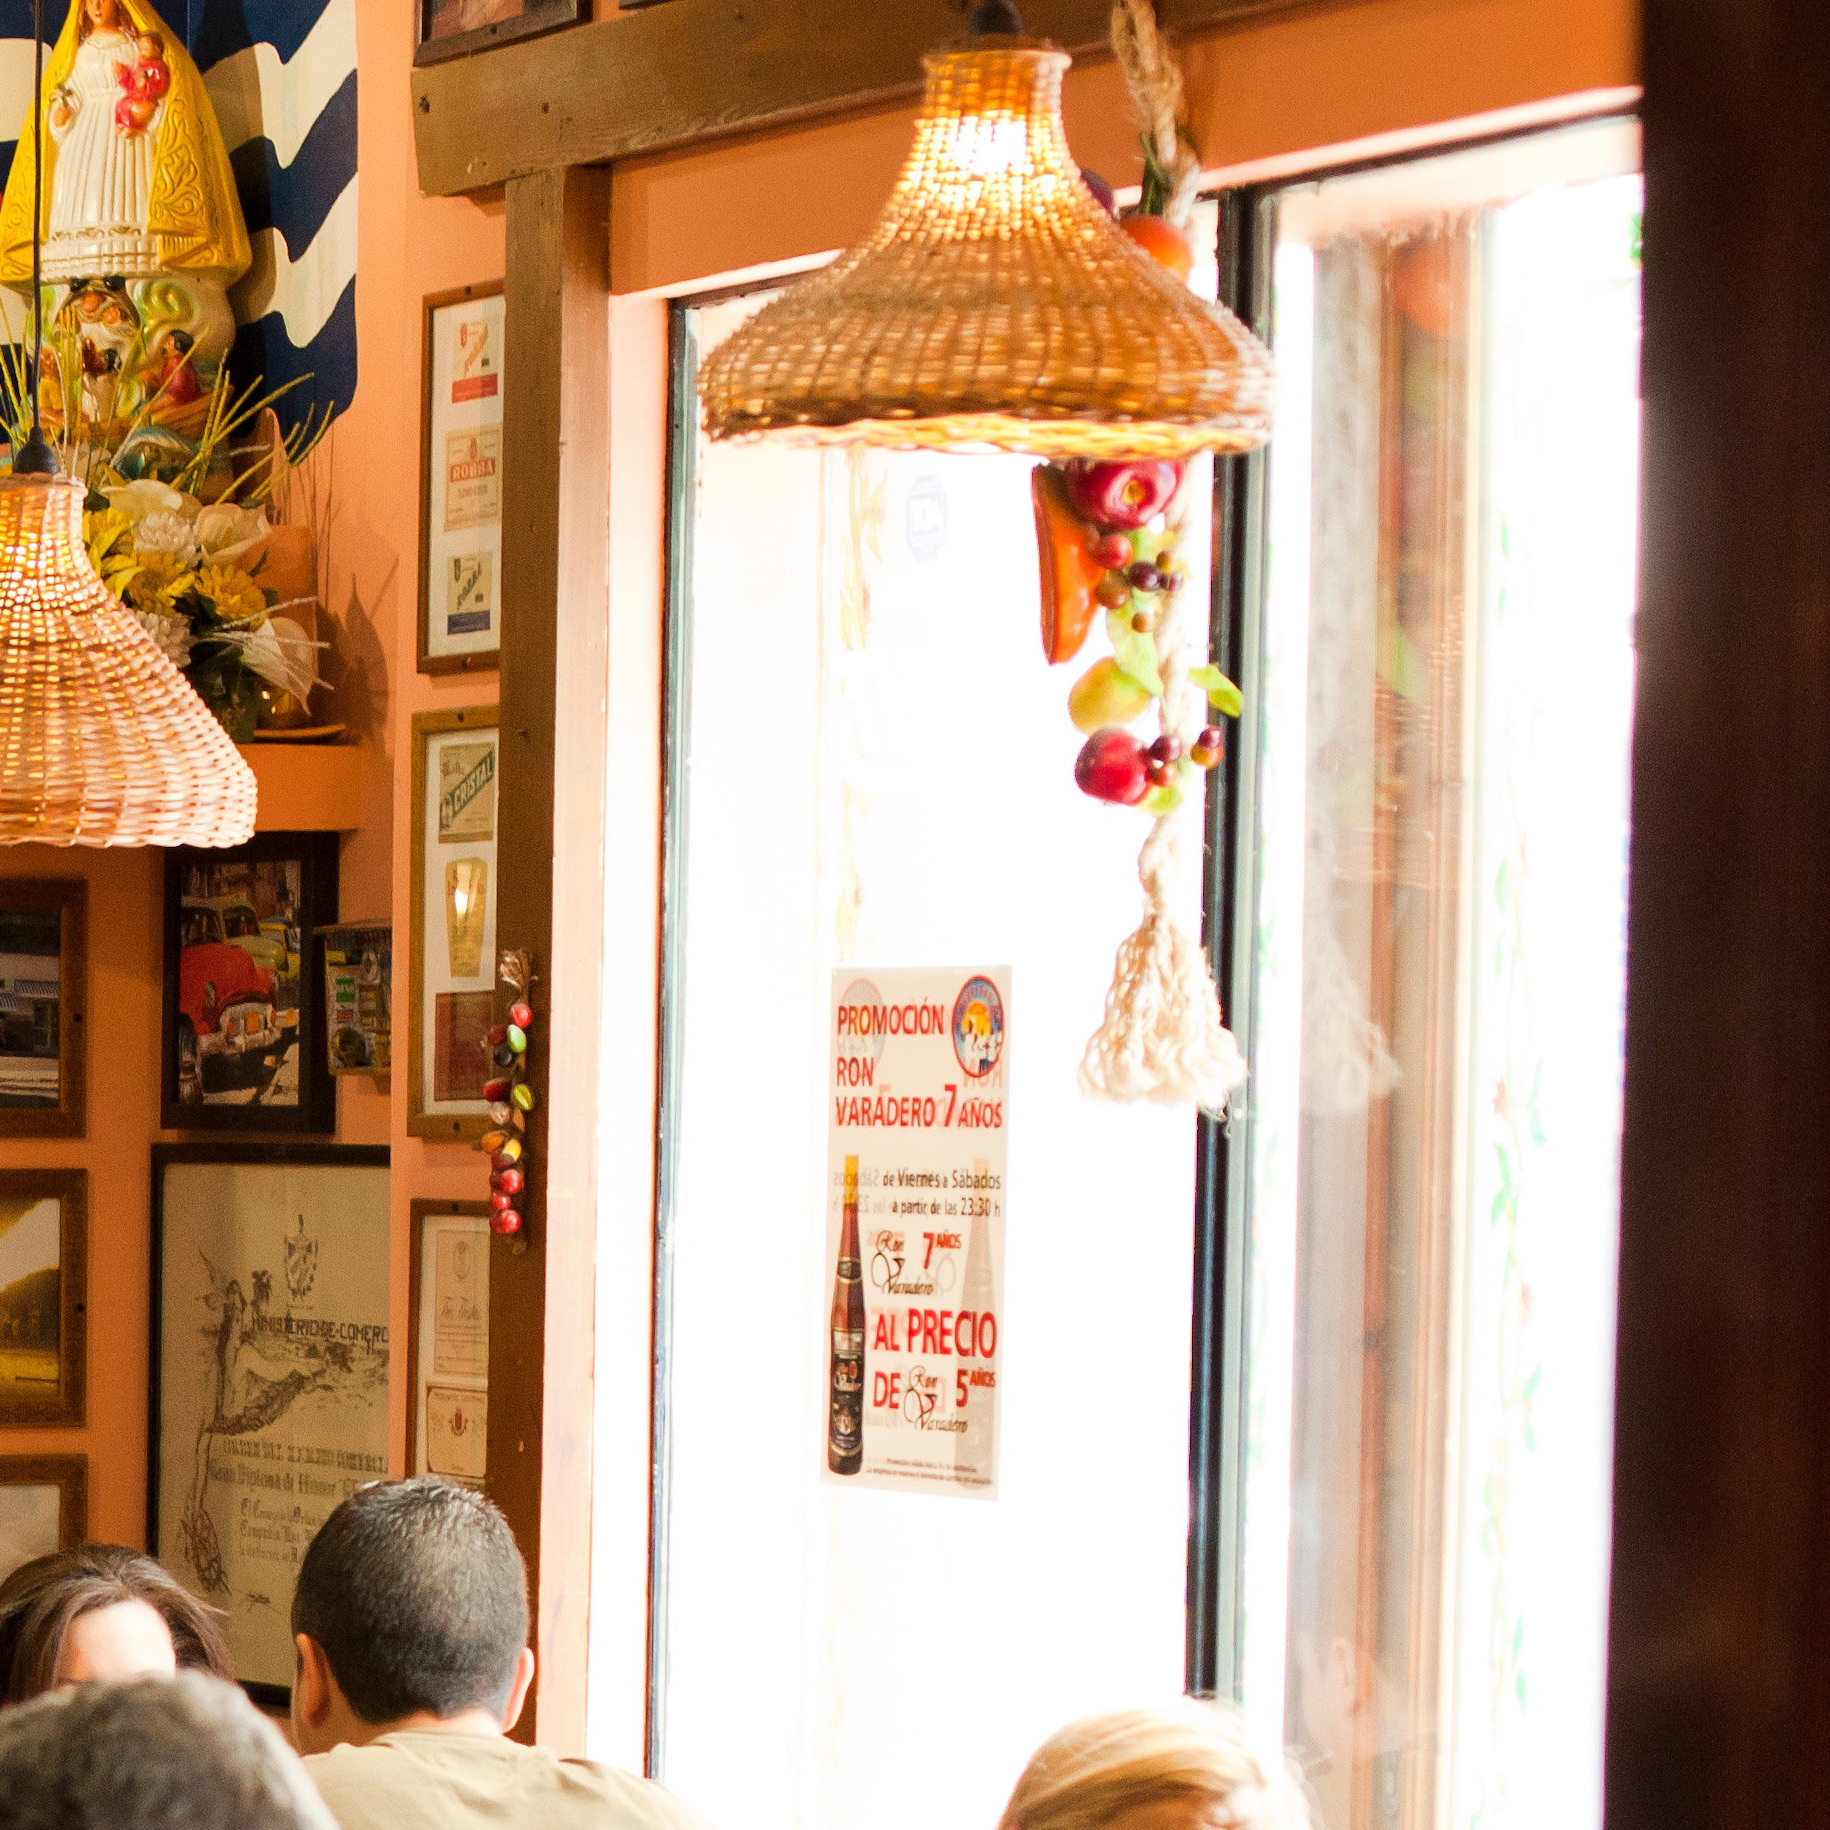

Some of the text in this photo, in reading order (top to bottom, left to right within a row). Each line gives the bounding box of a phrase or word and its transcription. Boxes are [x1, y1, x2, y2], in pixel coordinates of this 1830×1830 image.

[453, 754, 494, 813] CRISTAL
[837, 996, 945, 1036] PROMOCIÓN
[836, 1057, 874, 1087] RON
[835, 1084, 1003, 1129] VARADERO 7 AÑOS
[883, 1167, 1002, 1190] de Viernes a Sábados
[892, 1197, 1001, 1217] a partir de las 23:30 h
[923, 1231, 934, 1270] 7
[874, 1308, 997, 1358] AL PRECIO
[873, 1371, 901, 1410] DE
[956, 1368, 969, 1408] 5
